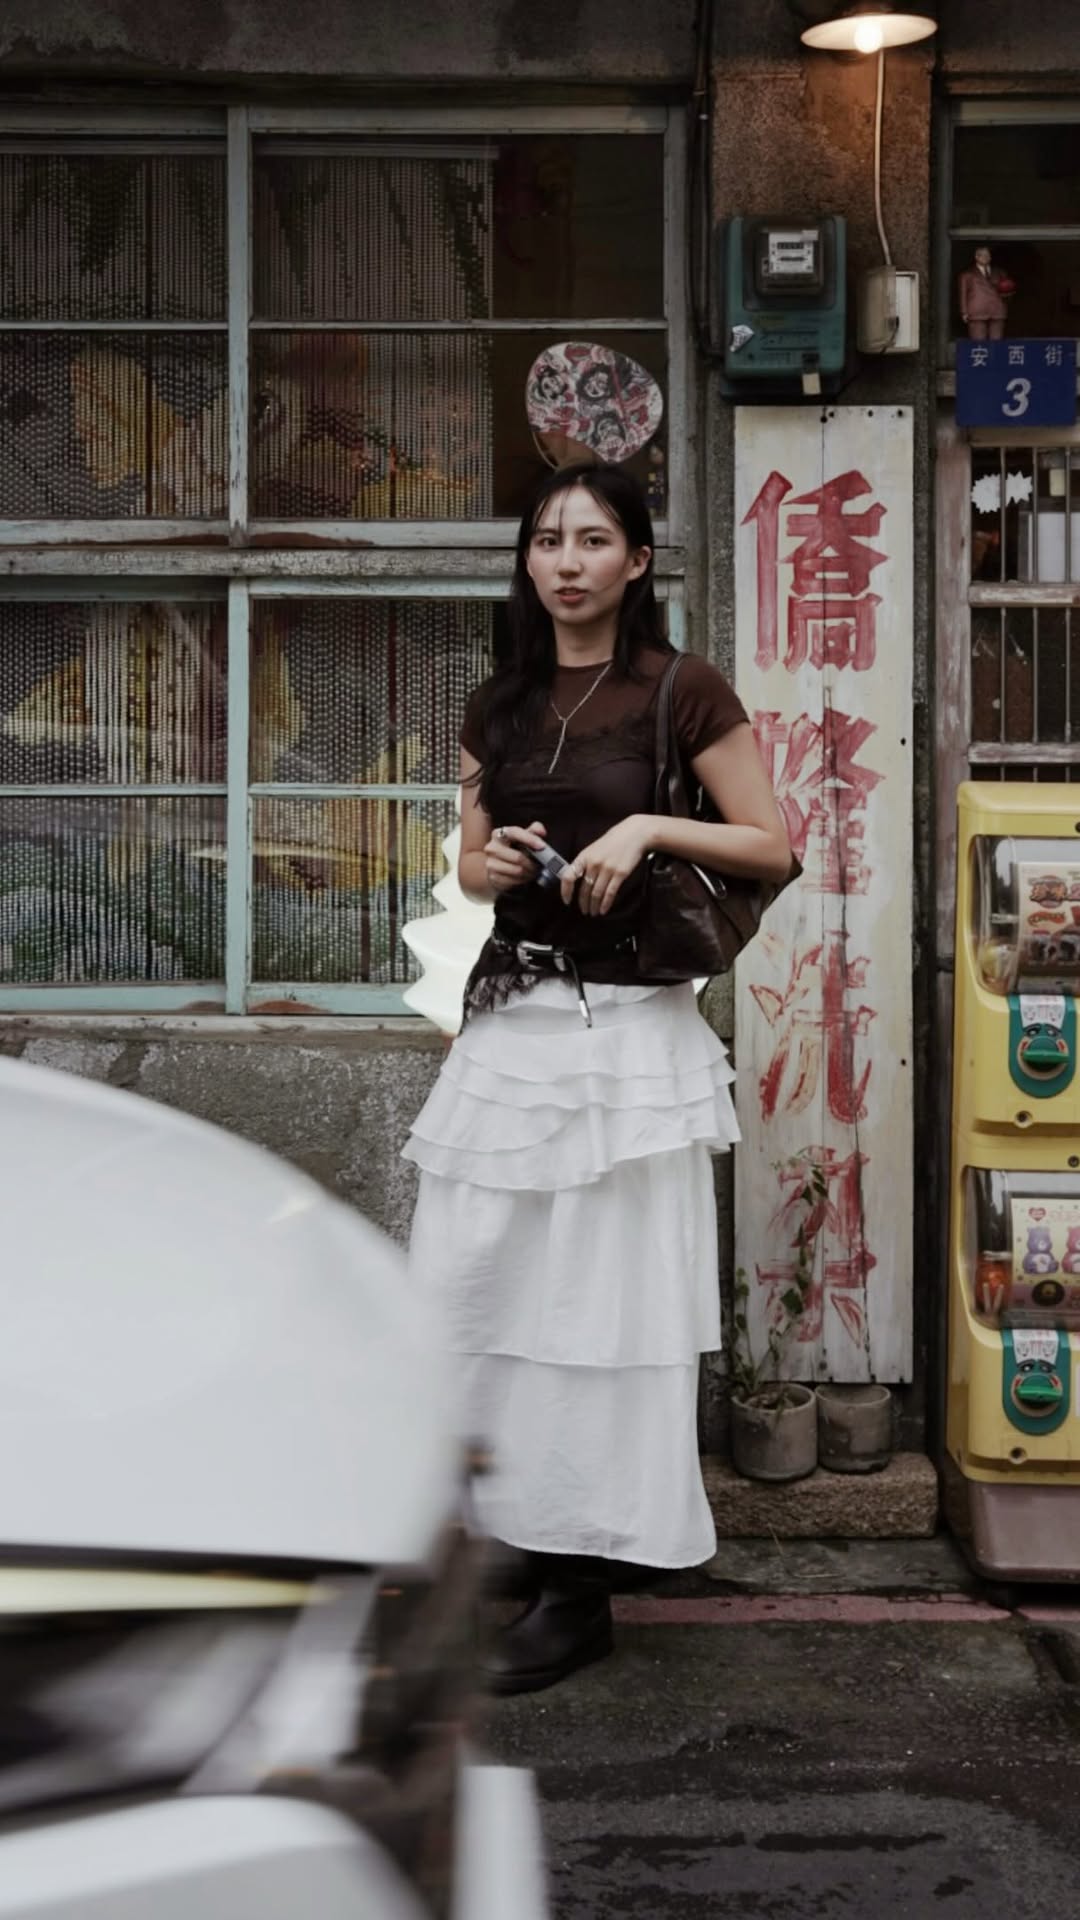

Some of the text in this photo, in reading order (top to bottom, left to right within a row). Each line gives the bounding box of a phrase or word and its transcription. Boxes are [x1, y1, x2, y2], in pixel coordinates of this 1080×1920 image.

[970, 344, 1063, 367] 安西街
[1002, 377, 1032, 417] 3
